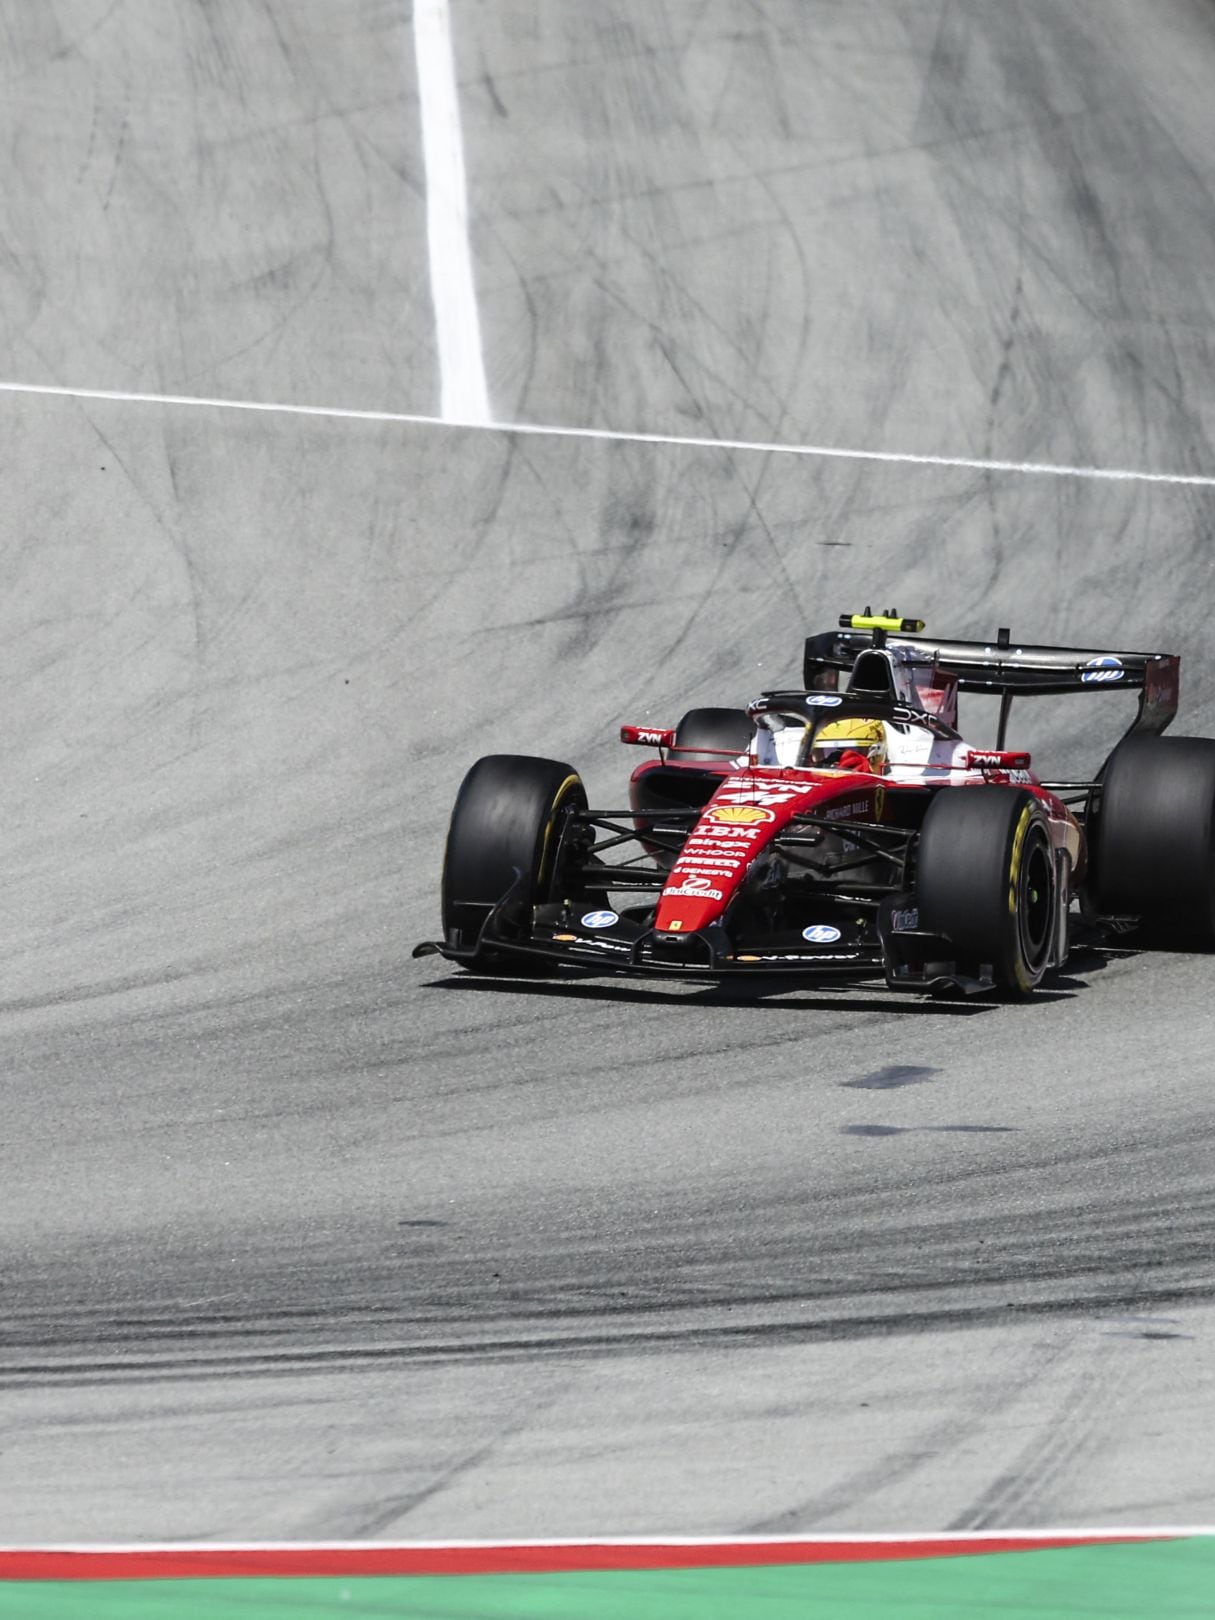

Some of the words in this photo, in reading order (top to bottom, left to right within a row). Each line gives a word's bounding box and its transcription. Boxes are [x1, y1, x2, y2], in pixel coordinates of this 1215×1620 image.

[806, 695, 843, 707] hp
[637, 732, 662, 744] ZYN
[973, 755, 1001, 765] ZYN
[716, 791, 797, 806] 44
[694, 826, 761, 840] IBM
[683, 848, 746, 858] WHOOP
[581, 910, 619, 928] hp
[802, 925, 841, 943] hp
